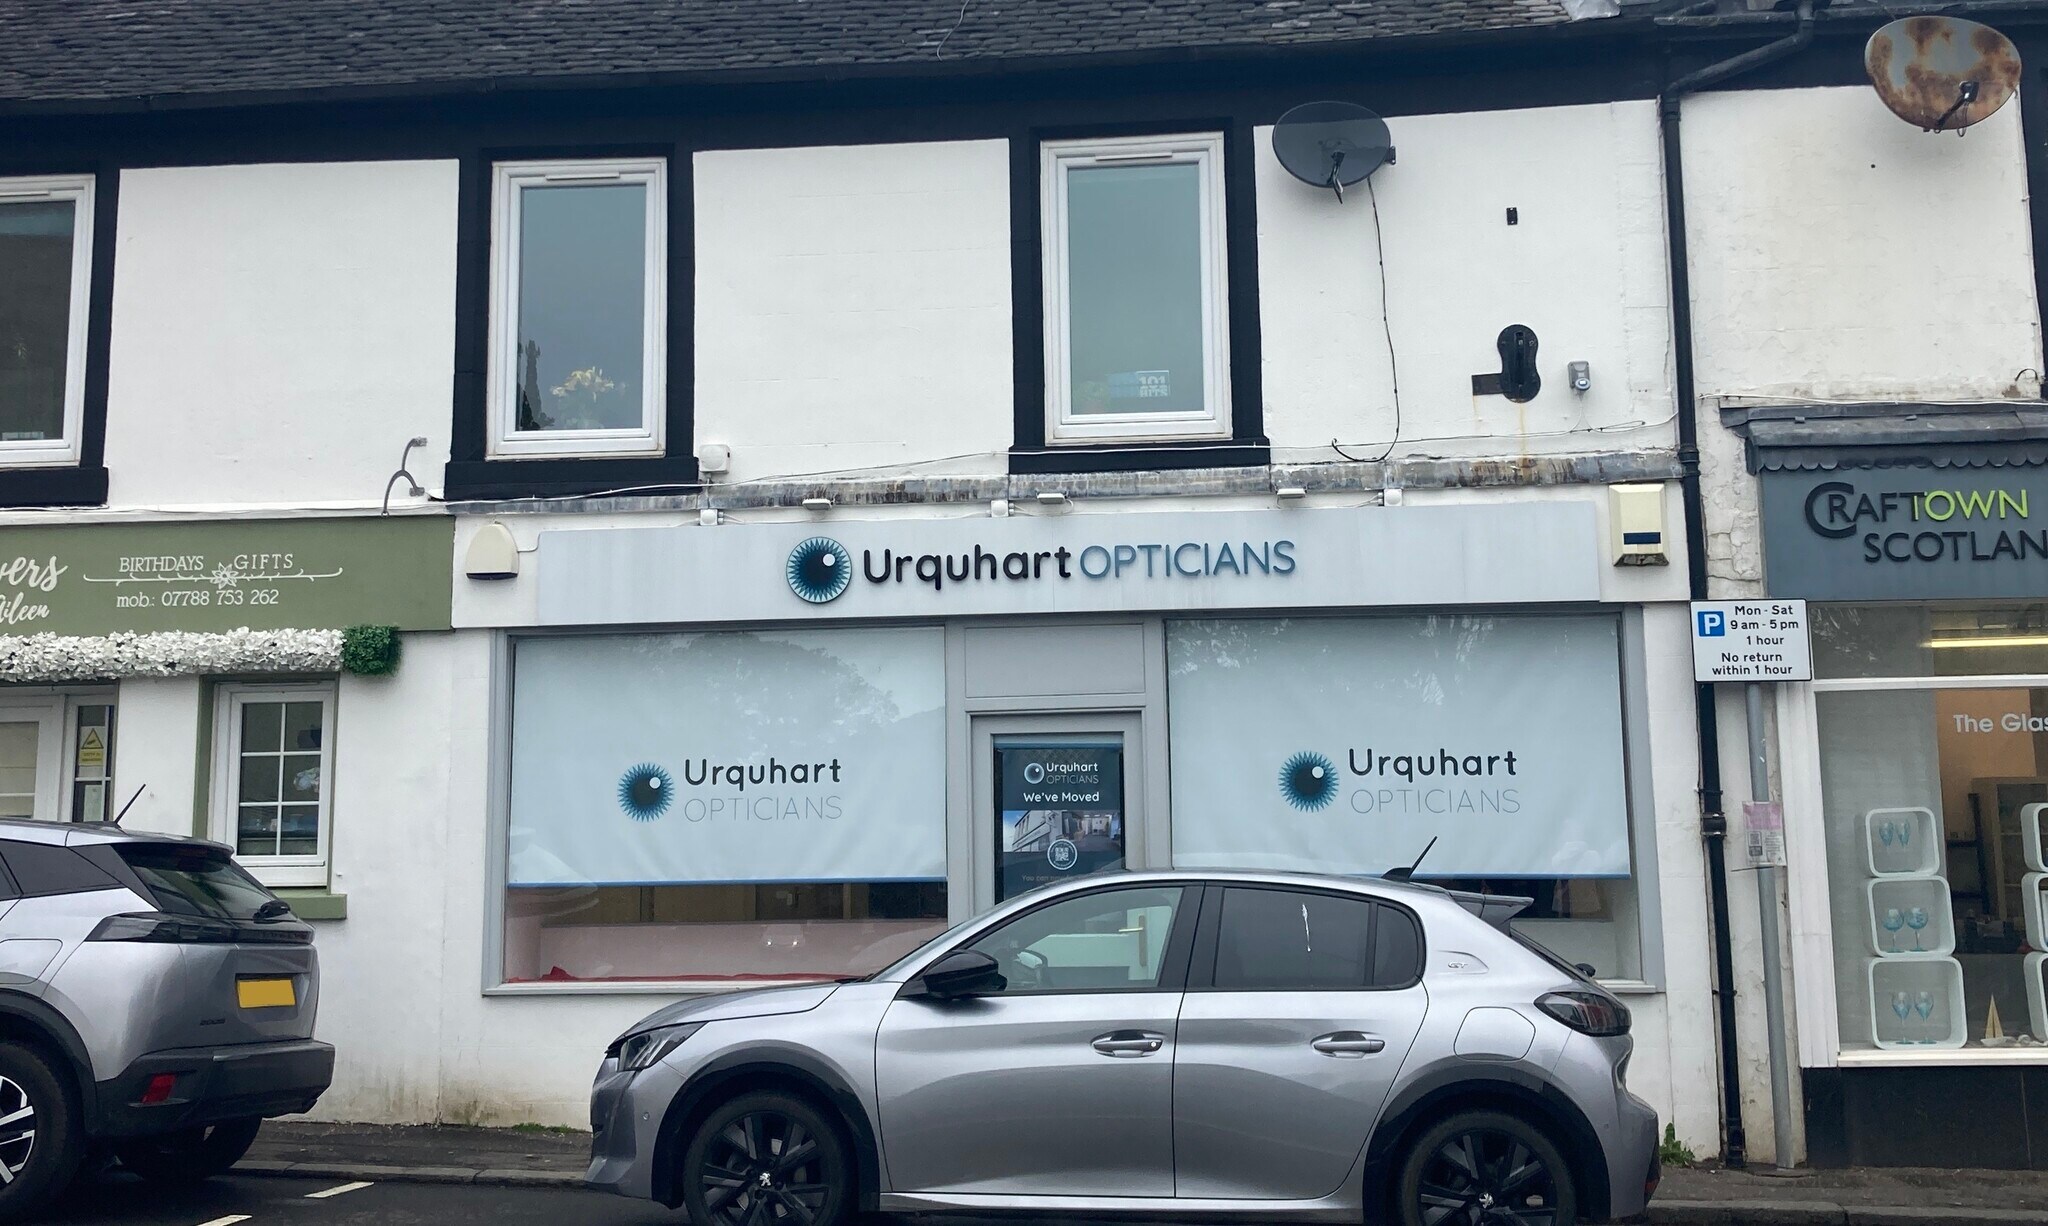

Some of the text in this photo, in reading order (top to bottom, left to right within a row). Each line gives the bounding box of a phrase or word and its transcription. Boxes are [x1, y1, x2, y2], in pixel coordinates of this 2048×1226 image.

[1805, 481, 2029, 540] CRAFTOWN
[119, 554, 294, 572] BIRTHDAYS GIFTS
[863, 540, 1297, 591] Urquhart OPTICIANS
[0, 555, 69, 592] ers
[161, 590, 210, 606] 07788
[216, 589, 244, 605] 753
[250, 589, 280, 605] 262
[1734, 605, 1762, 616] Mon
[1771, 605, 1794, 615] Sat
[1703, 613, 1721, 635] P
[1730, 620, 1738, 630] 9
[1741, 621, 1760, 630] am
[1769, 619, 1778, 629] 5
[1780, 620, 1799, 631] pm
[1746, 635, 1785, 645] 1 hour
[1721, 652, 1783, 663] No return
[1712, 665, 1793, 675] within 1 hour
[1953, 713, 1994, 733] The
[685, 757, 842, 792] Urquhart
[1046, 762, 1099, 774] Urquhart
[1349, 748, 1518, 784] Urquhart
[1046, 774, 1100, 784] OPTICIANS
[1023, 791, 1100, 802] We've Moved
[1350, 788, 1521, 814] OPTICIANS
[684, 795, 843, 822] OPTICIANS
